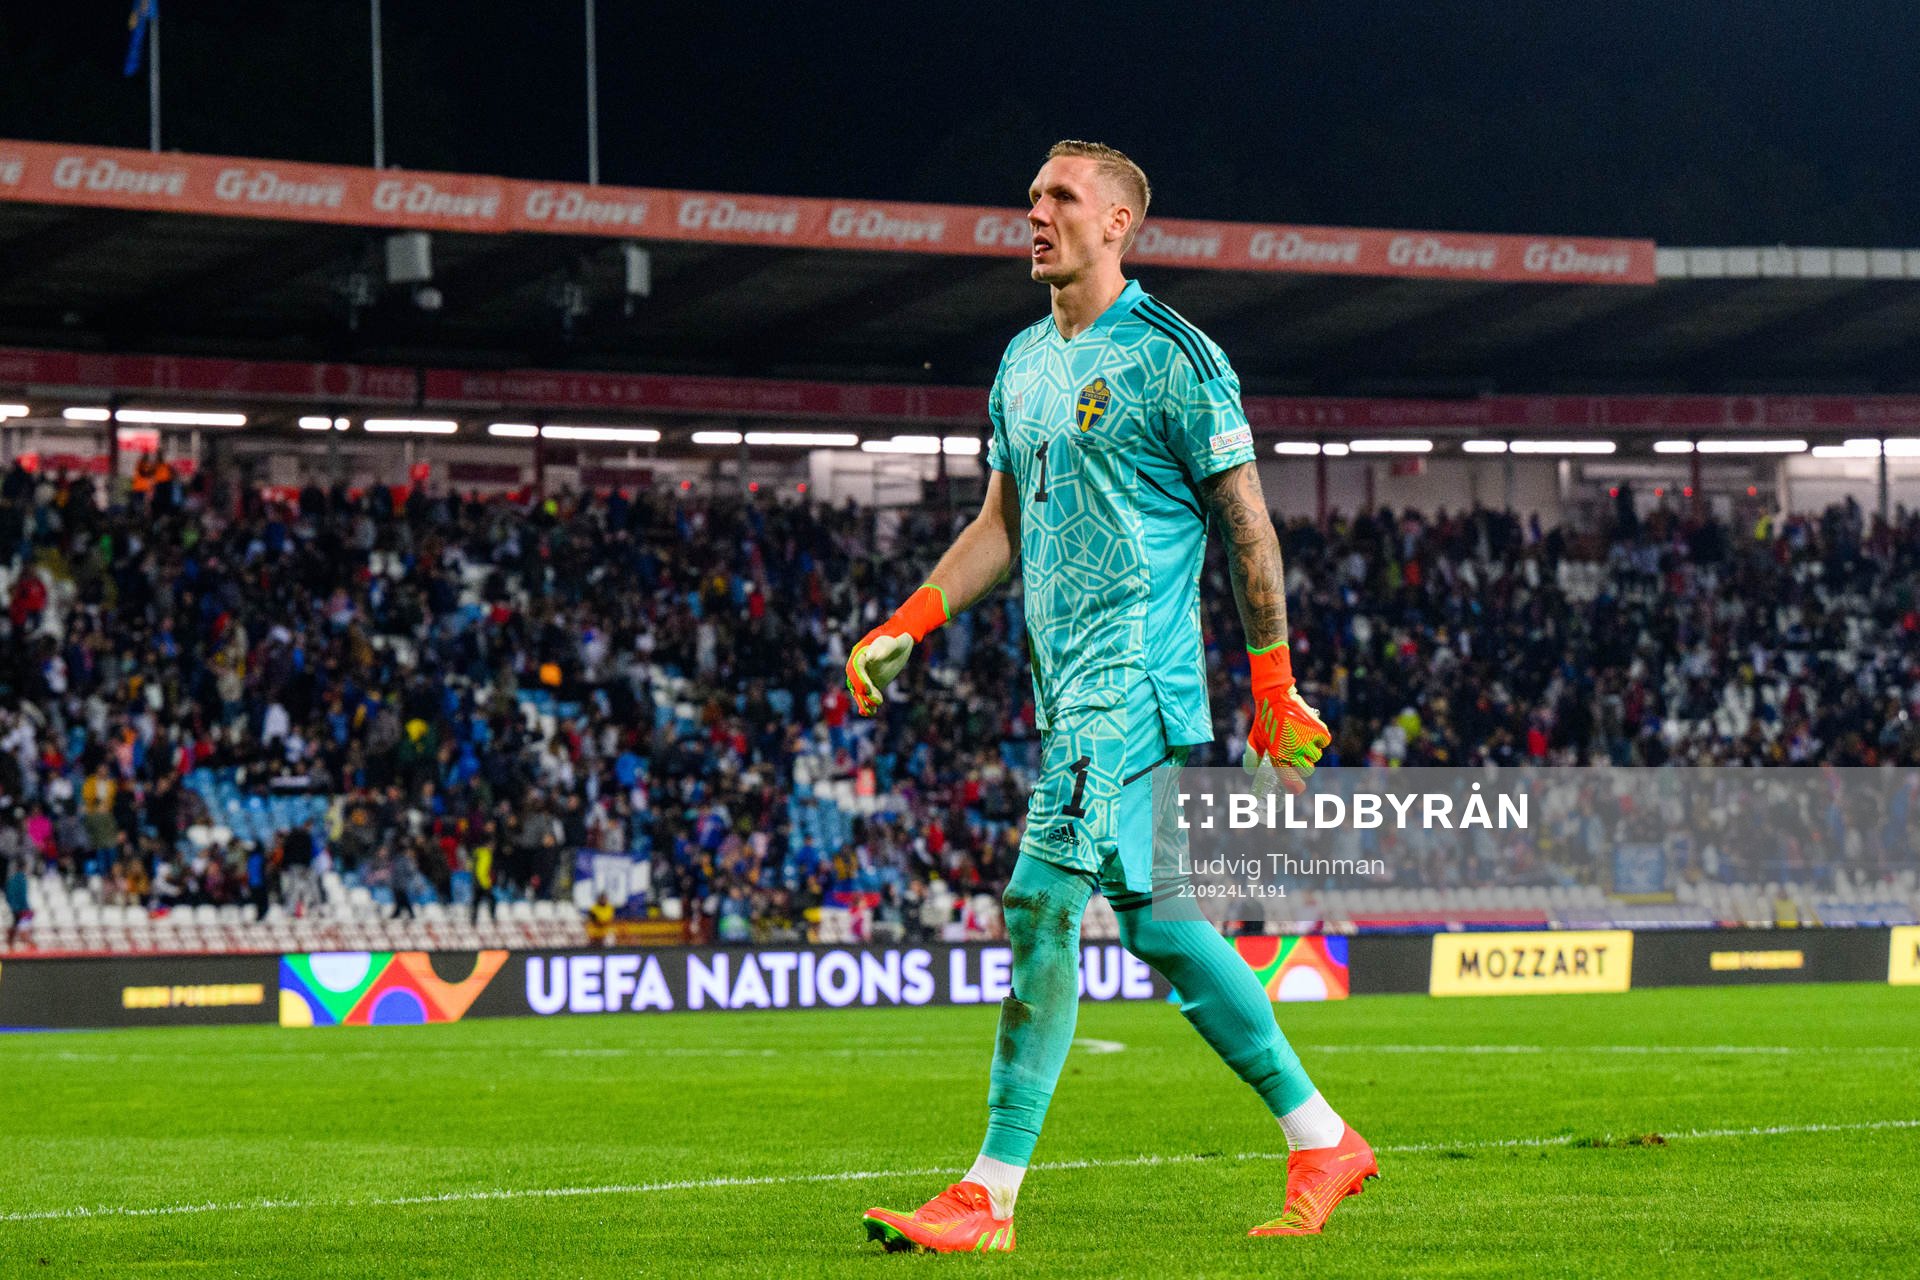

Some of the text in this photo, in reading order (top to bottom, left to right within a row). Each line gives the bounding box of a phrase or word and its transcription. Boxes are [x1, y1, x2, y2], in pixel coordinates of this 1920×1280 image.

[1035, 441, 1048, 502] 1
[1061, 755, 1091, 819] 1
[1049, 832, 1080, 846] adidas
[525, 946, 1154, 1014] UEFA NATIONS LEUE
[1459, 946, 1608, 979] MOZZART
